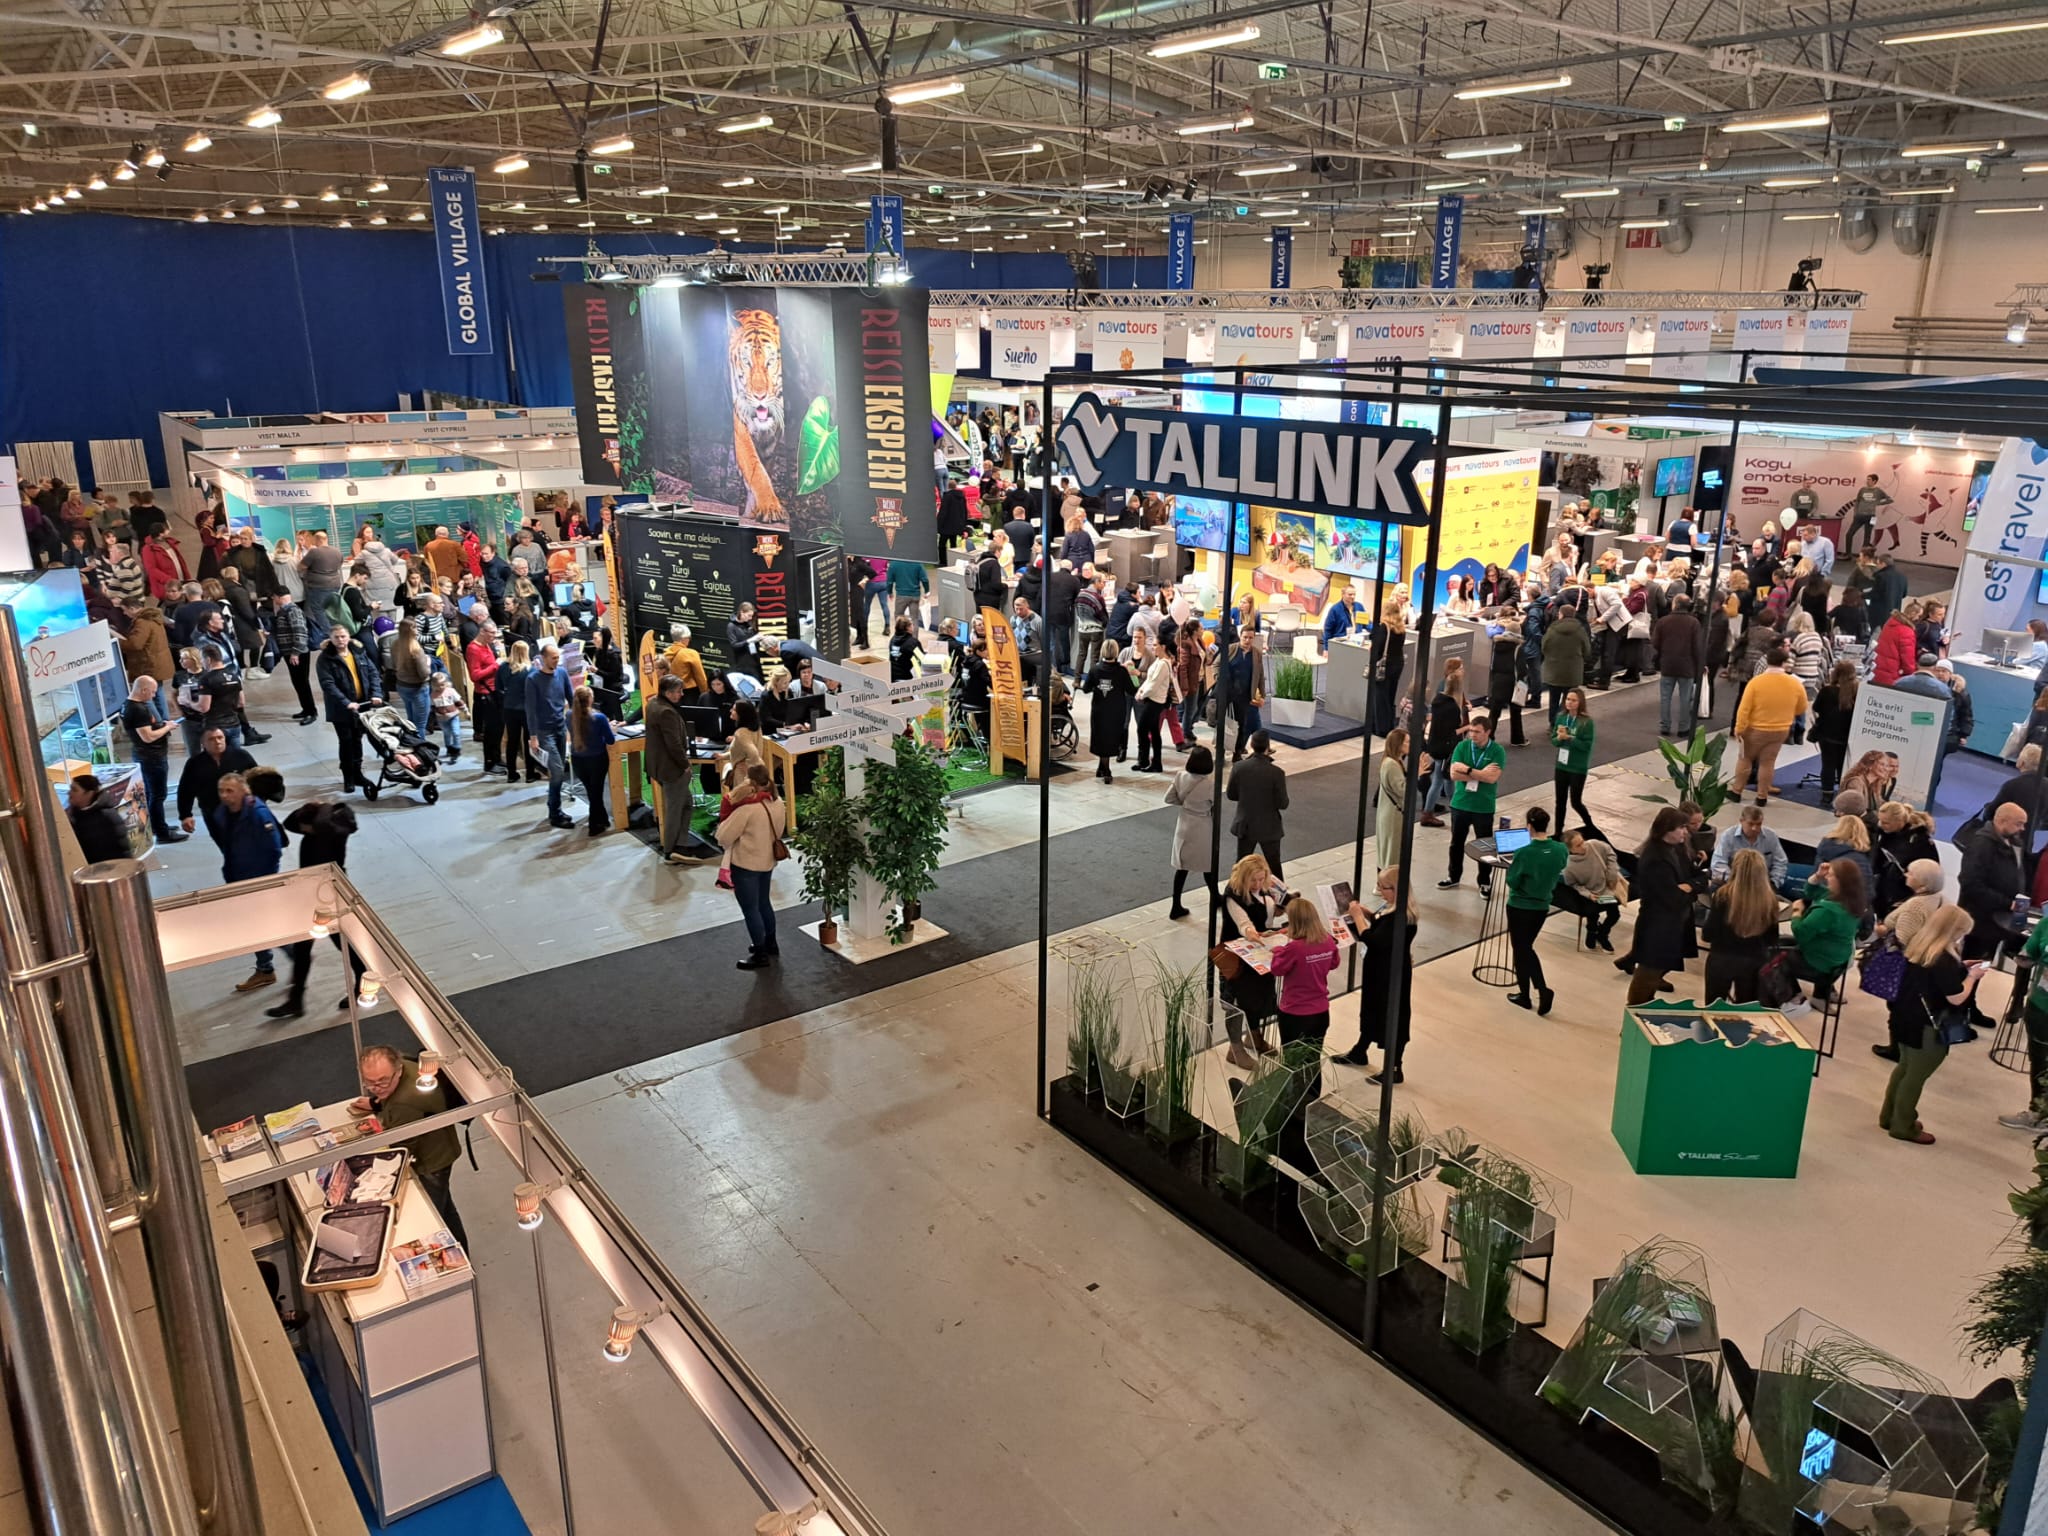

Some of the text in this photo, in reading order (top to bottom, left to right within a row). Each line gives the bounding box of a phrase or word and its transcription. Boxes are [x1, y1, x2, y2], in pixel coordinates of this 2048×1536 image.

[1439, 215, 1454, 281] VILLAGE
[1175, 229, 1186, 284] VILLAGE
[1276, 240, 1286, 287] VILLAGE
[446, 191, 478, 345] GLOBAL VILLAGE
[996, 317, 1045, 331] novatours
[1098, 319, 1157, 334] novatours
[1221, 322, 1293, 339] novatours
[1356, 323, 1424, 339] novatours
[1470, 320, 1531, 336] novatours
[1570, 319, 1624, 334] novatours
[1660, 318, 1708, 333] novatours
[1739, 317, 1782, 331] novatours
[1808, 317, 1847, 330] novatours
[1003, 345, 1037, 364] Sueño
[860, 308, 907, 494] REISIEKSPERT
[276, 431, 301, 439] MALTA
[441, 425, 467, 433] CYPRUS
[1125, 417, 1416, 515] TALLINK
[1745, 458, 1791, 471] Kogu
[275, 489, 312, 497] TRAVEL
[674, 532, 682, 541] et
[684, 533, 697, 542] ma
[672, 564, 690, 576] Türgi
[703, 580, 731, 593] Egiptus
[912, 678, 944, 693] puhkeala
[1867, 695, 1904, 713] Üks eriti
[1864, 708, 1895, 721] mõnus
[1863, 716, 1907, 733] lojaalsus-
[809, 728, 848, 746] Elamused
[849, 730, 857, 740] ja
[1861, 726, 1909, 744] programm
[1687, 1152, 1721, 1160] TALLINK
